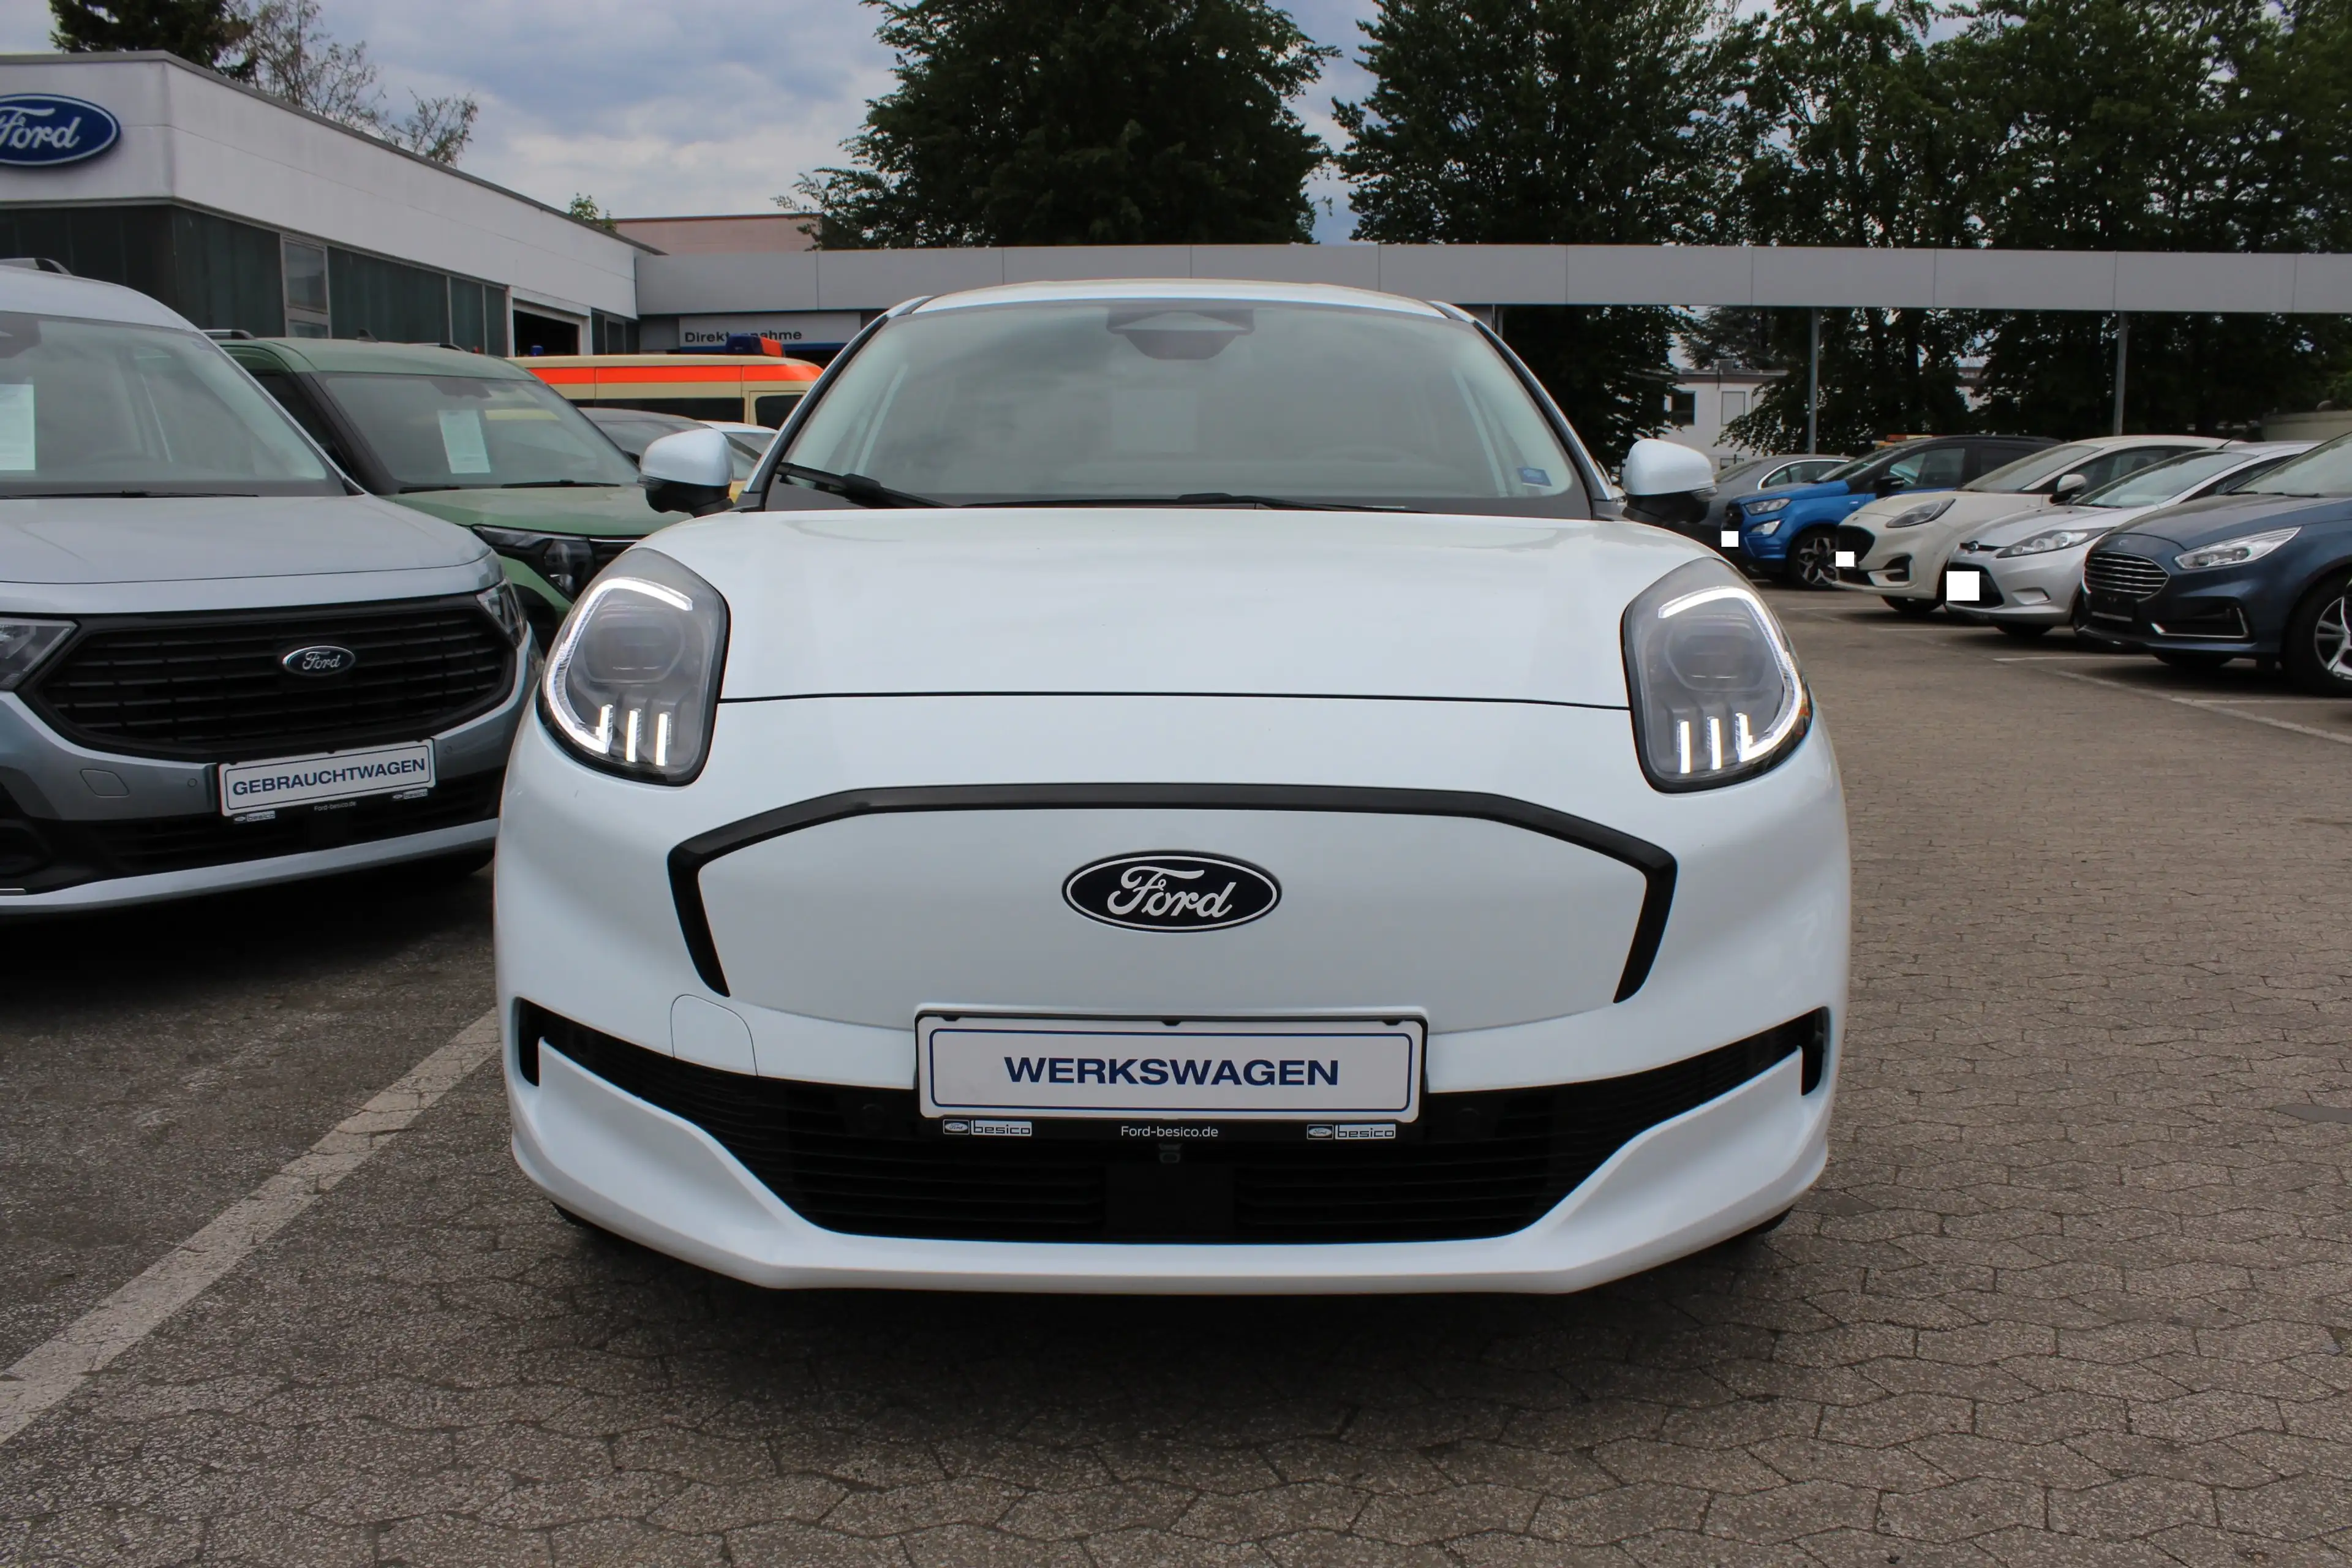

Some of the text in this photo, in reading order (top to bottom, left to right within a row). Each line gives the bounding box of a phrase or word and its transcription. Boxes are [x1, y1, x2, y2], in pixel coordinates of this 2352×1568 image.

[303, 650, 341, 670] Ford
[232, 758, 426, 796] GEBRAUCHTWAGEN
[1107, 865, 1237, 918] Ford
[1003, 1057, 1339, 1086] WERKSWAGEN
[973, 1120, 1031, 1134] besico
[1121, 1126, 1218, 1137] Ford-besico.de
[1337, 1125, 1395, 1138] besico
